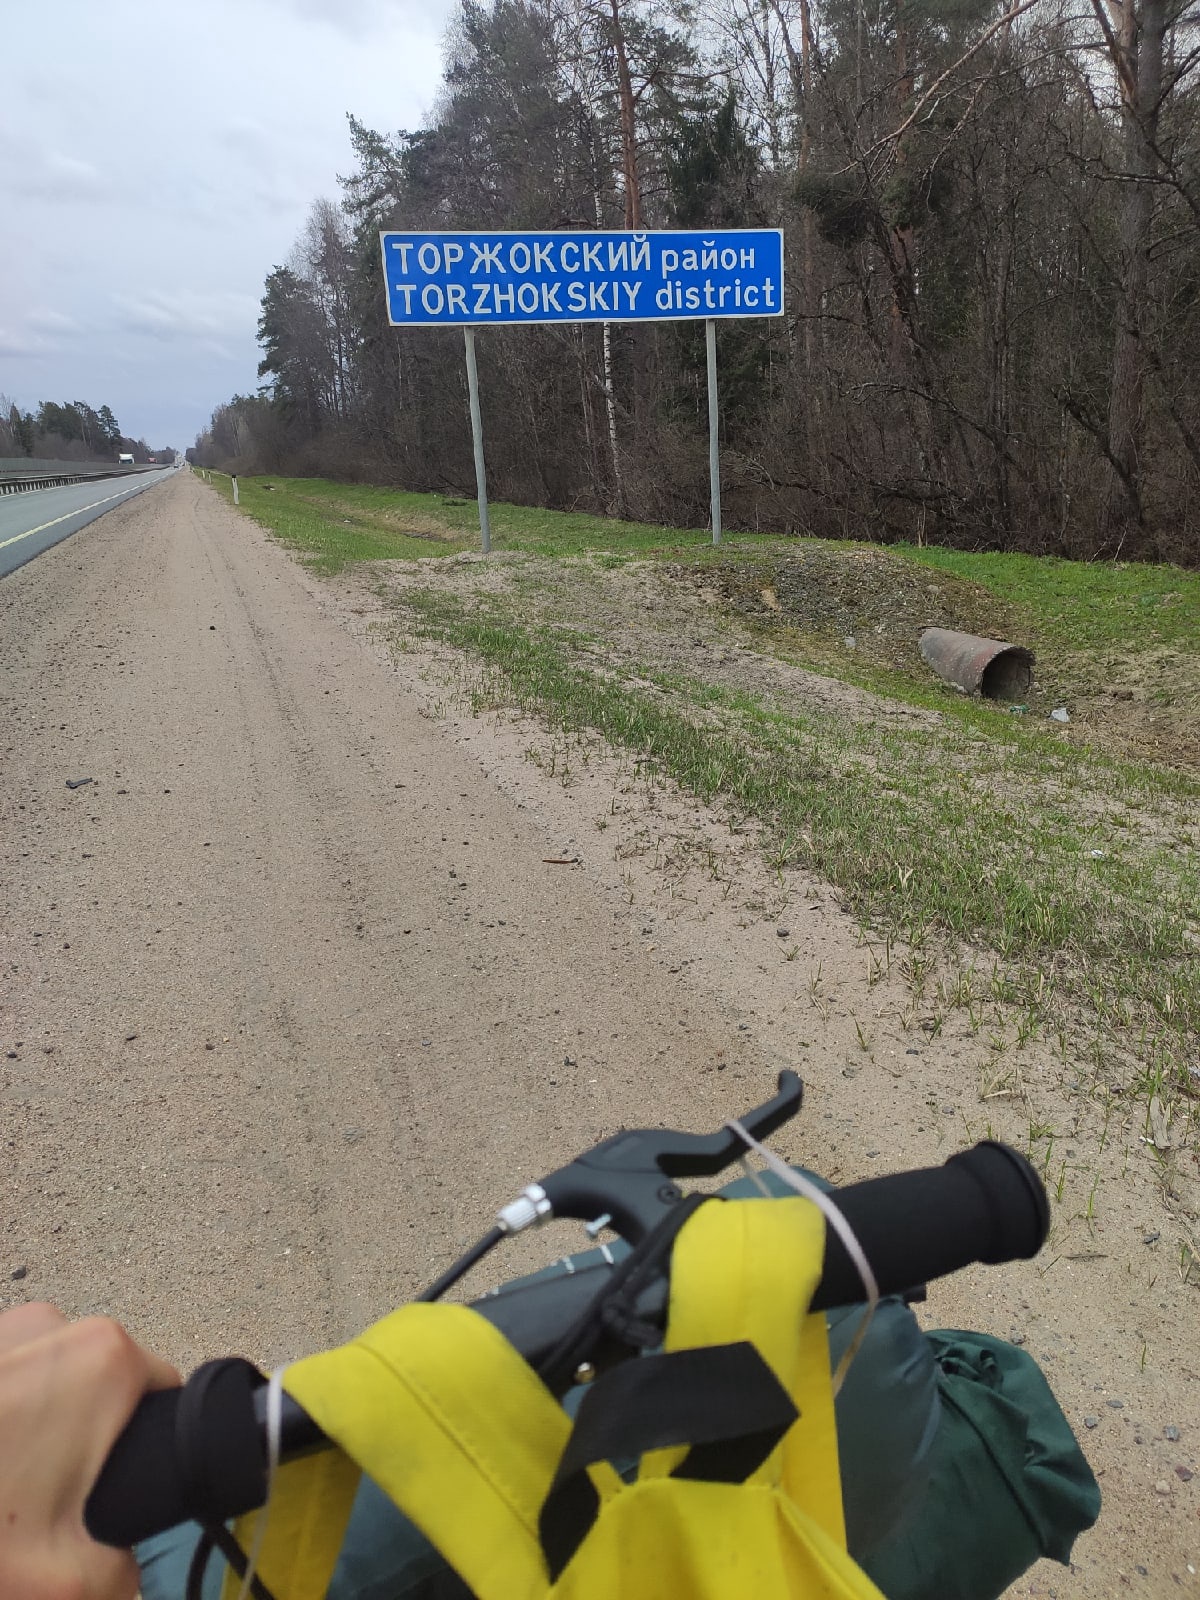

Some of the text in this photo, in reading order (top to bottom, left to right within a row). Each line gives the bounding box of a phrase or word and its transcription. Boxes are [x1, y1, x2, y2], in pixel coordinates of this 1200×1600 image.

[391, 234, 755, 279] ТОРЖОКСКИЙ район
[395, 277, 775, 315] TORZHOKSKIY district
